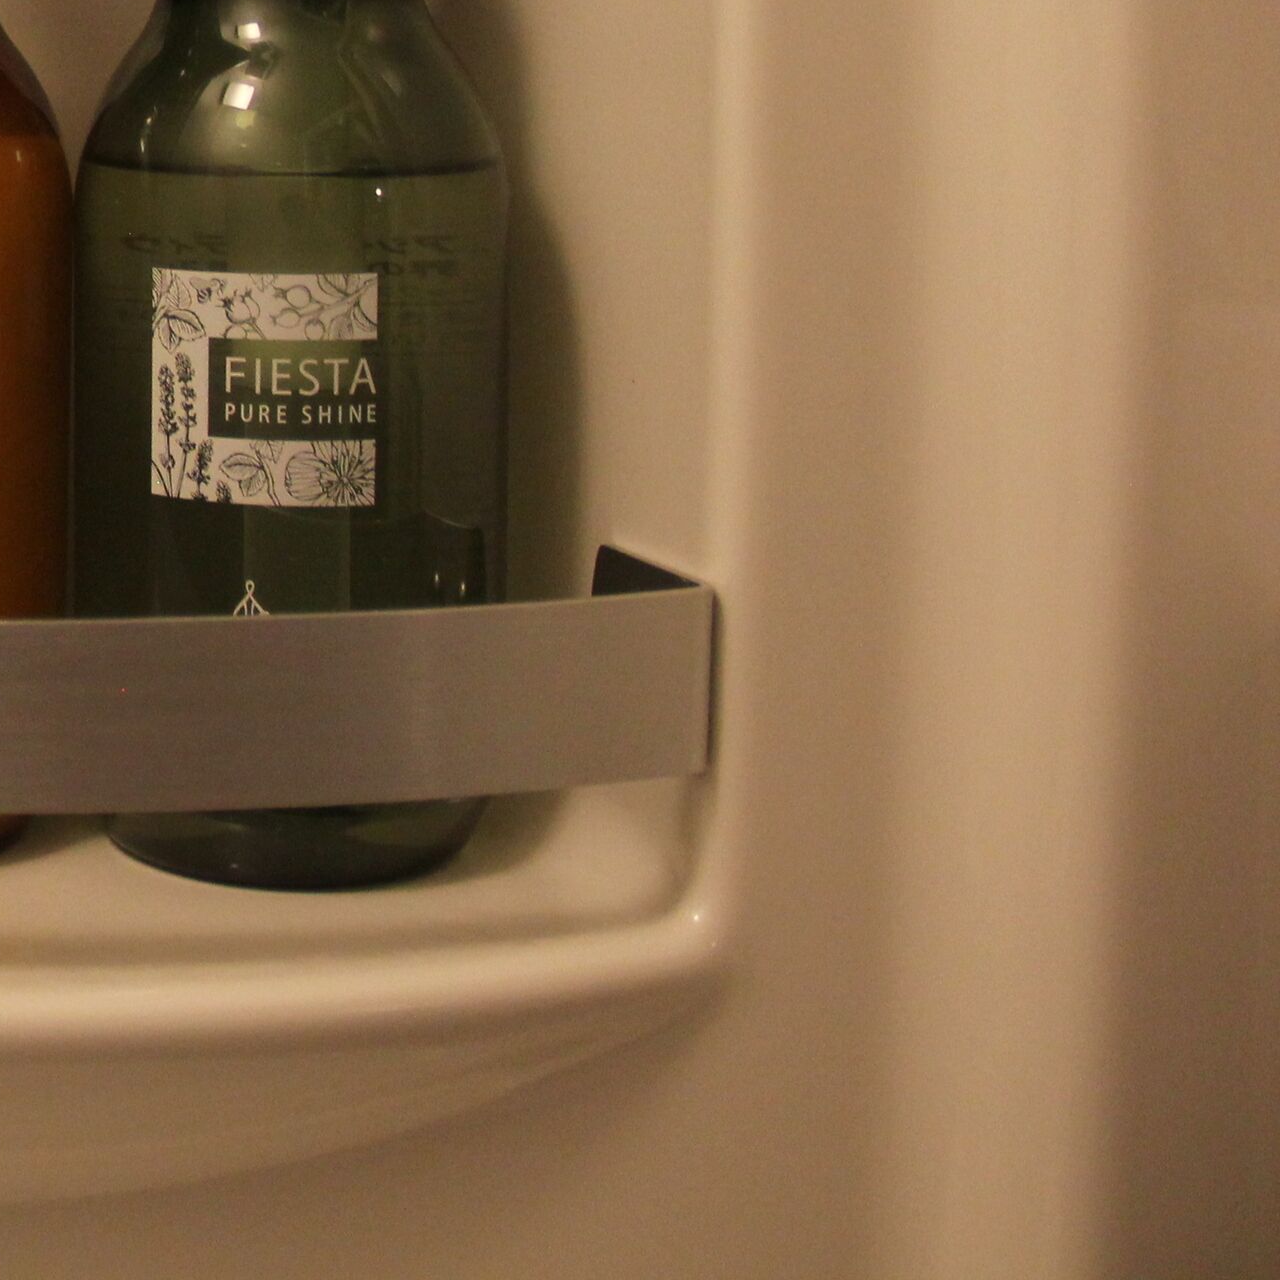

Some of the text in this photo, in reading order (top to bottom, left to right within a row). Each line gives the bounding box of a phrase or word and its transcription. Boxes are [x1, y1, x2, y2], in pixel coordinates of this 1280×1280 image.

[225, 356, 376, 396] FIESTA
[225, 403, 377, 424] PURE SHINE
